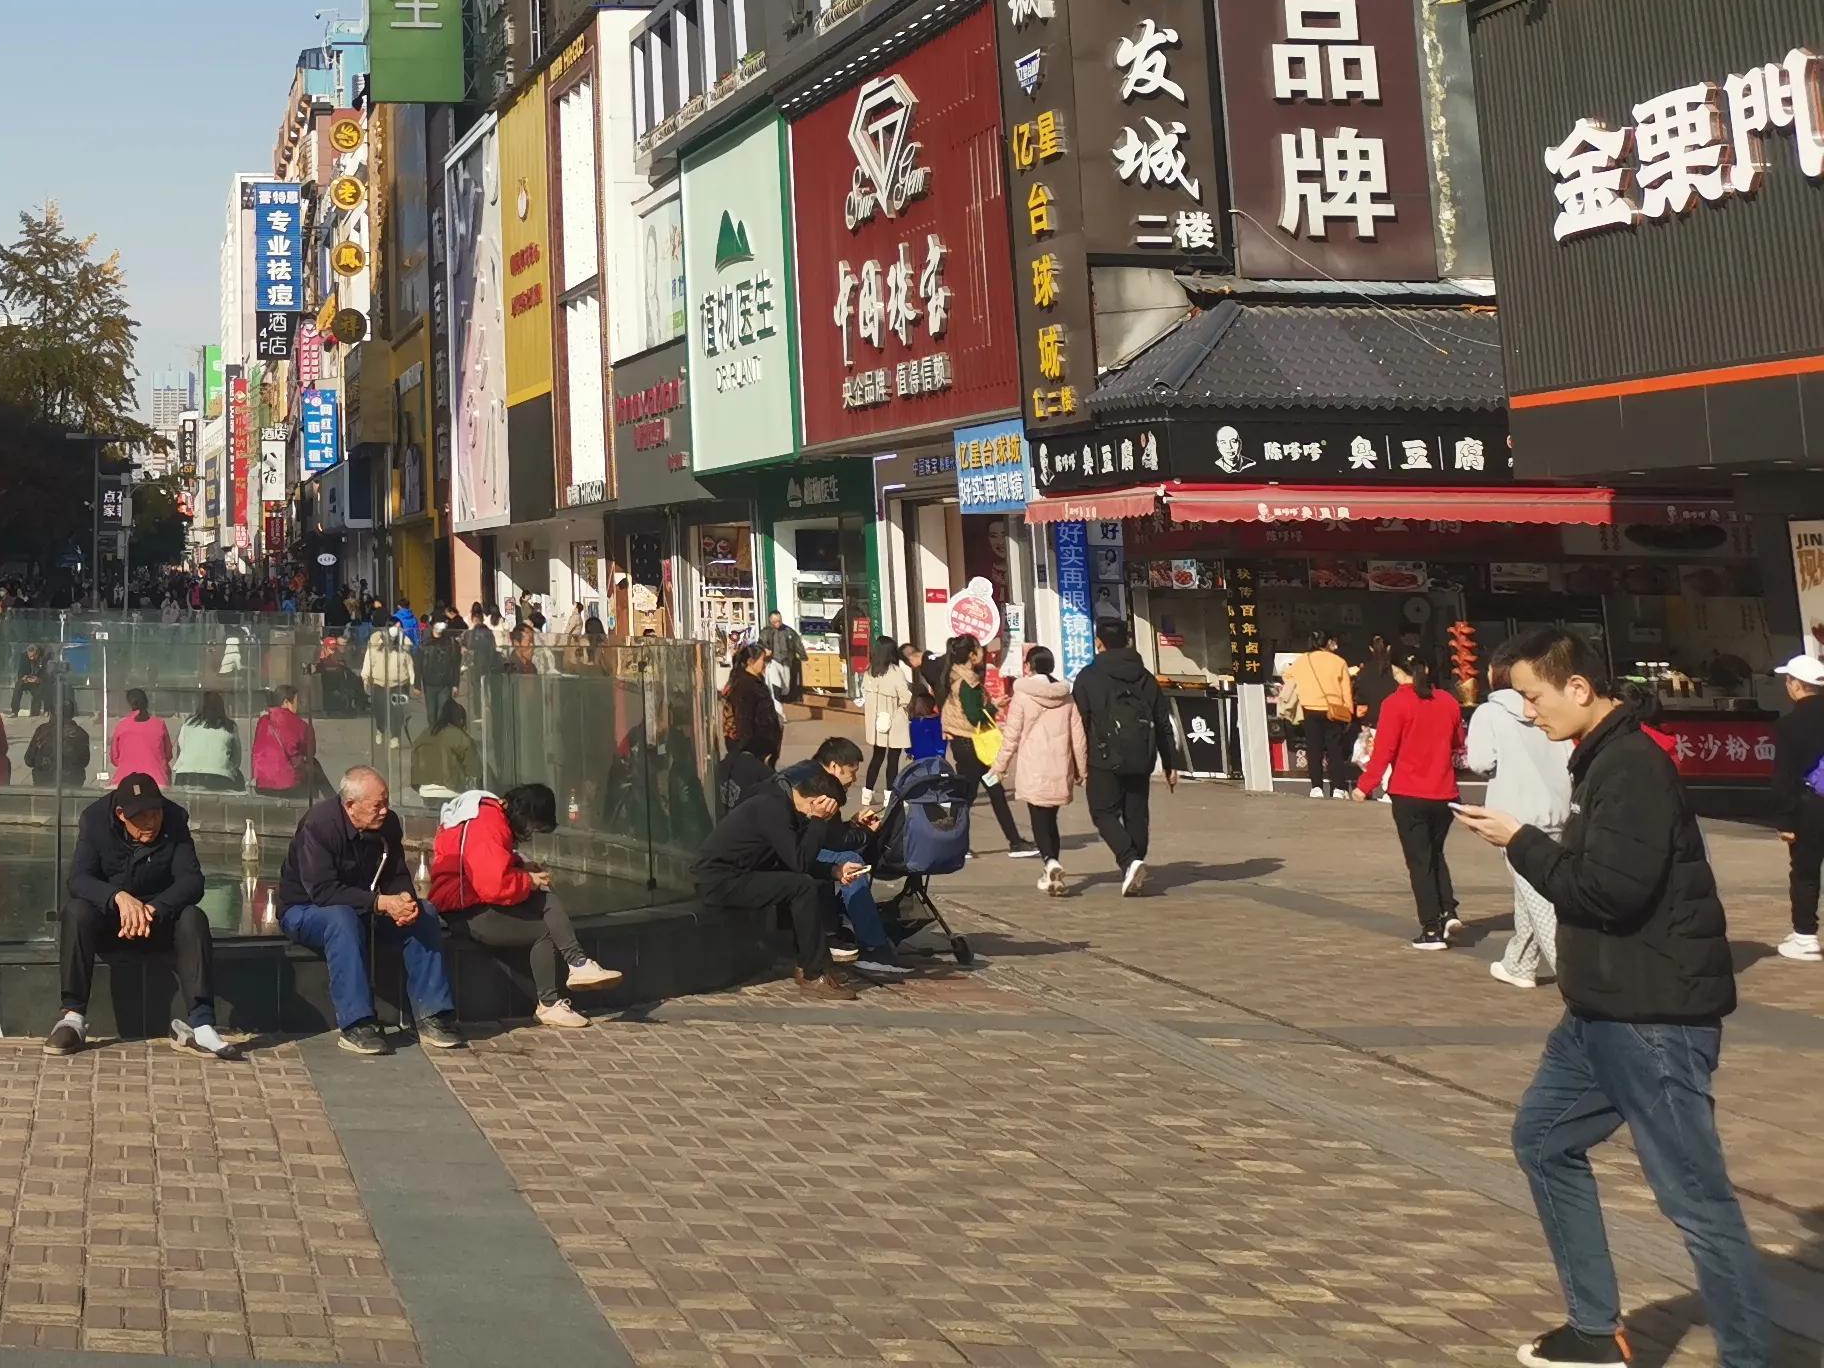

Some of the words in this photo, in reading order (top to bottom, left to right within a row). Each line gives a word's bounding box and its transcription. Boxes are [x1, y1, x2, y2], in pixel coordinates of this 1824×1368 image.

[1135, 213, 1216, 251] 二楼
[267, 210, 294, 306] 专业祛痘
[700, 269, 778, 358] 植物医生
[268, 313, 288, 355] 酒店
[842, 369, 889, 410] 央企品牌
[896, 353, 946, 397] 值得信赖
[958, 433, 1023, 470] 亿星台球城
[1348, 435, 1486, 471] 臭豆腐
[959, 471, 1025, 505] 好实再眼镜
[1187, 716, 1216, 745] 臭
[1674, 733, 1776, 762] 长沙粉面
